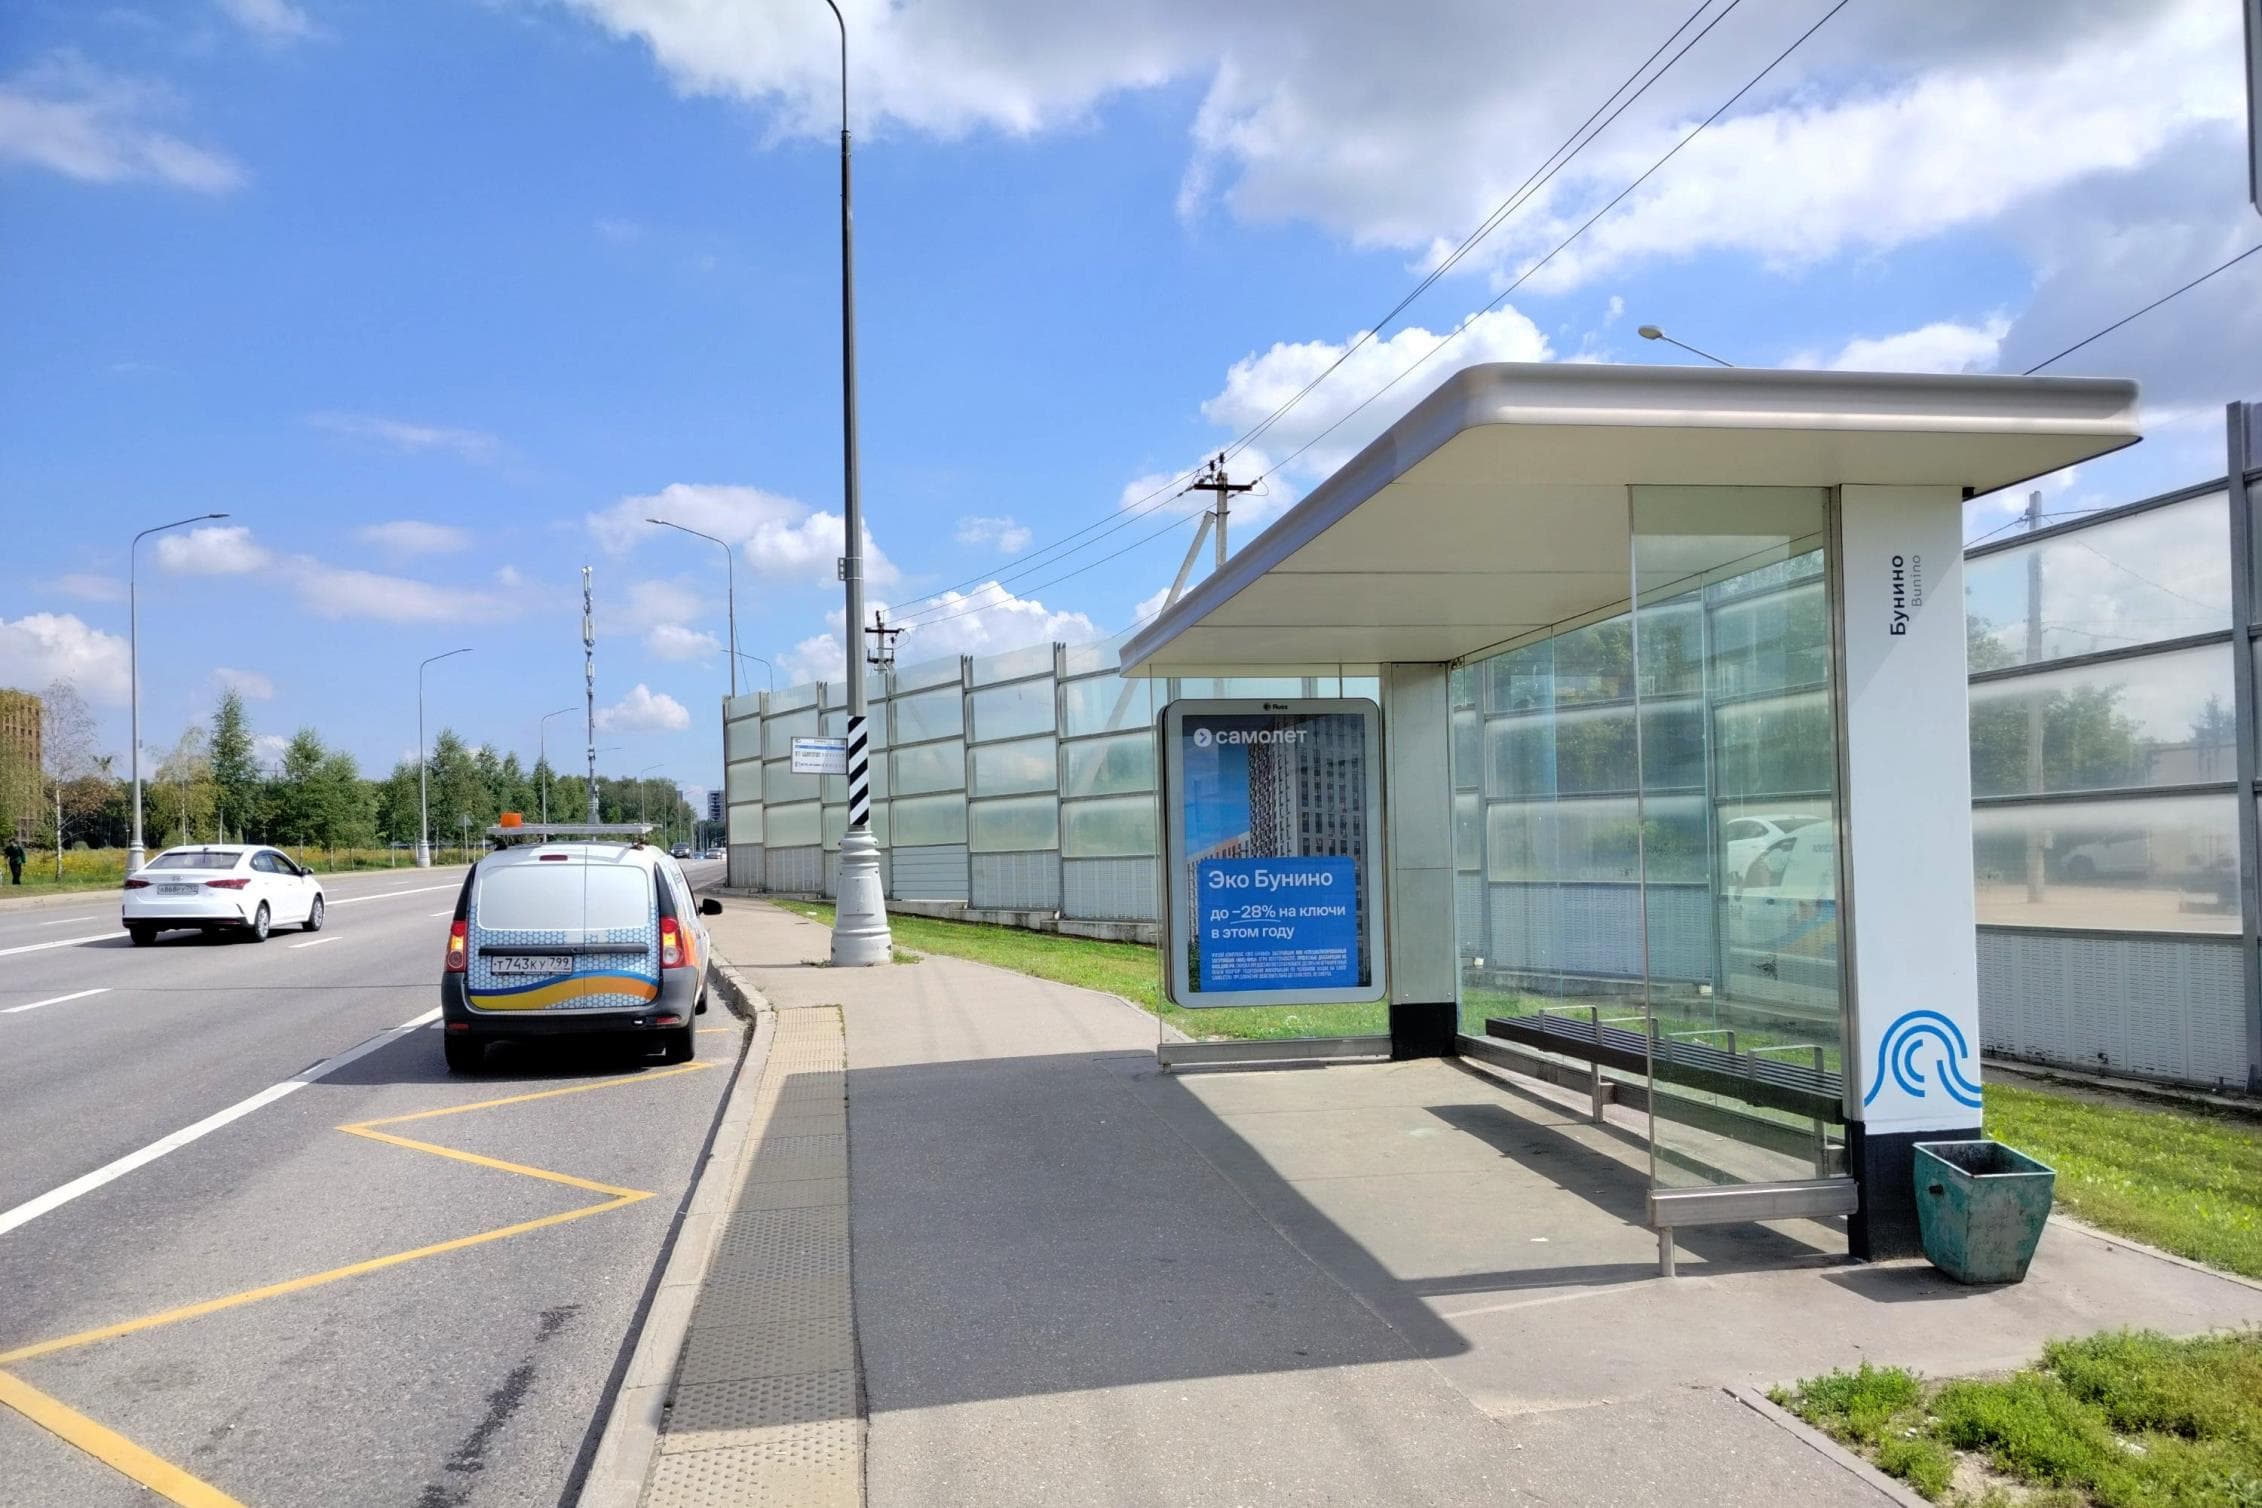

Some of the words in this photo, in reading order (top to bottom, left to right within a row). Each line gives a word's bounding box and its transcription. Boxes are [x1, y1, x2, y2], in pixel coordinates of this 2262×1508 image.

[1911, 555, 1922, 606] Bunino
[1890, 555, 1909, 635] Бунино
[1216, 730, 1307, 744] самолет
[1209, 870, 1249, 889] Эко
[1255, 869, 1333, 891] Бунино
[1210, 909, 1229, 921] до
[1280, 907, 1296, 917] на
[1299, 906, 1346, 916] ключи
[1211, 929, 1219, 938] в
[1223, 928, 1259, 938] этом
[1263, 927, 1295, 939] году
[550, 957, 569, 967] 799
